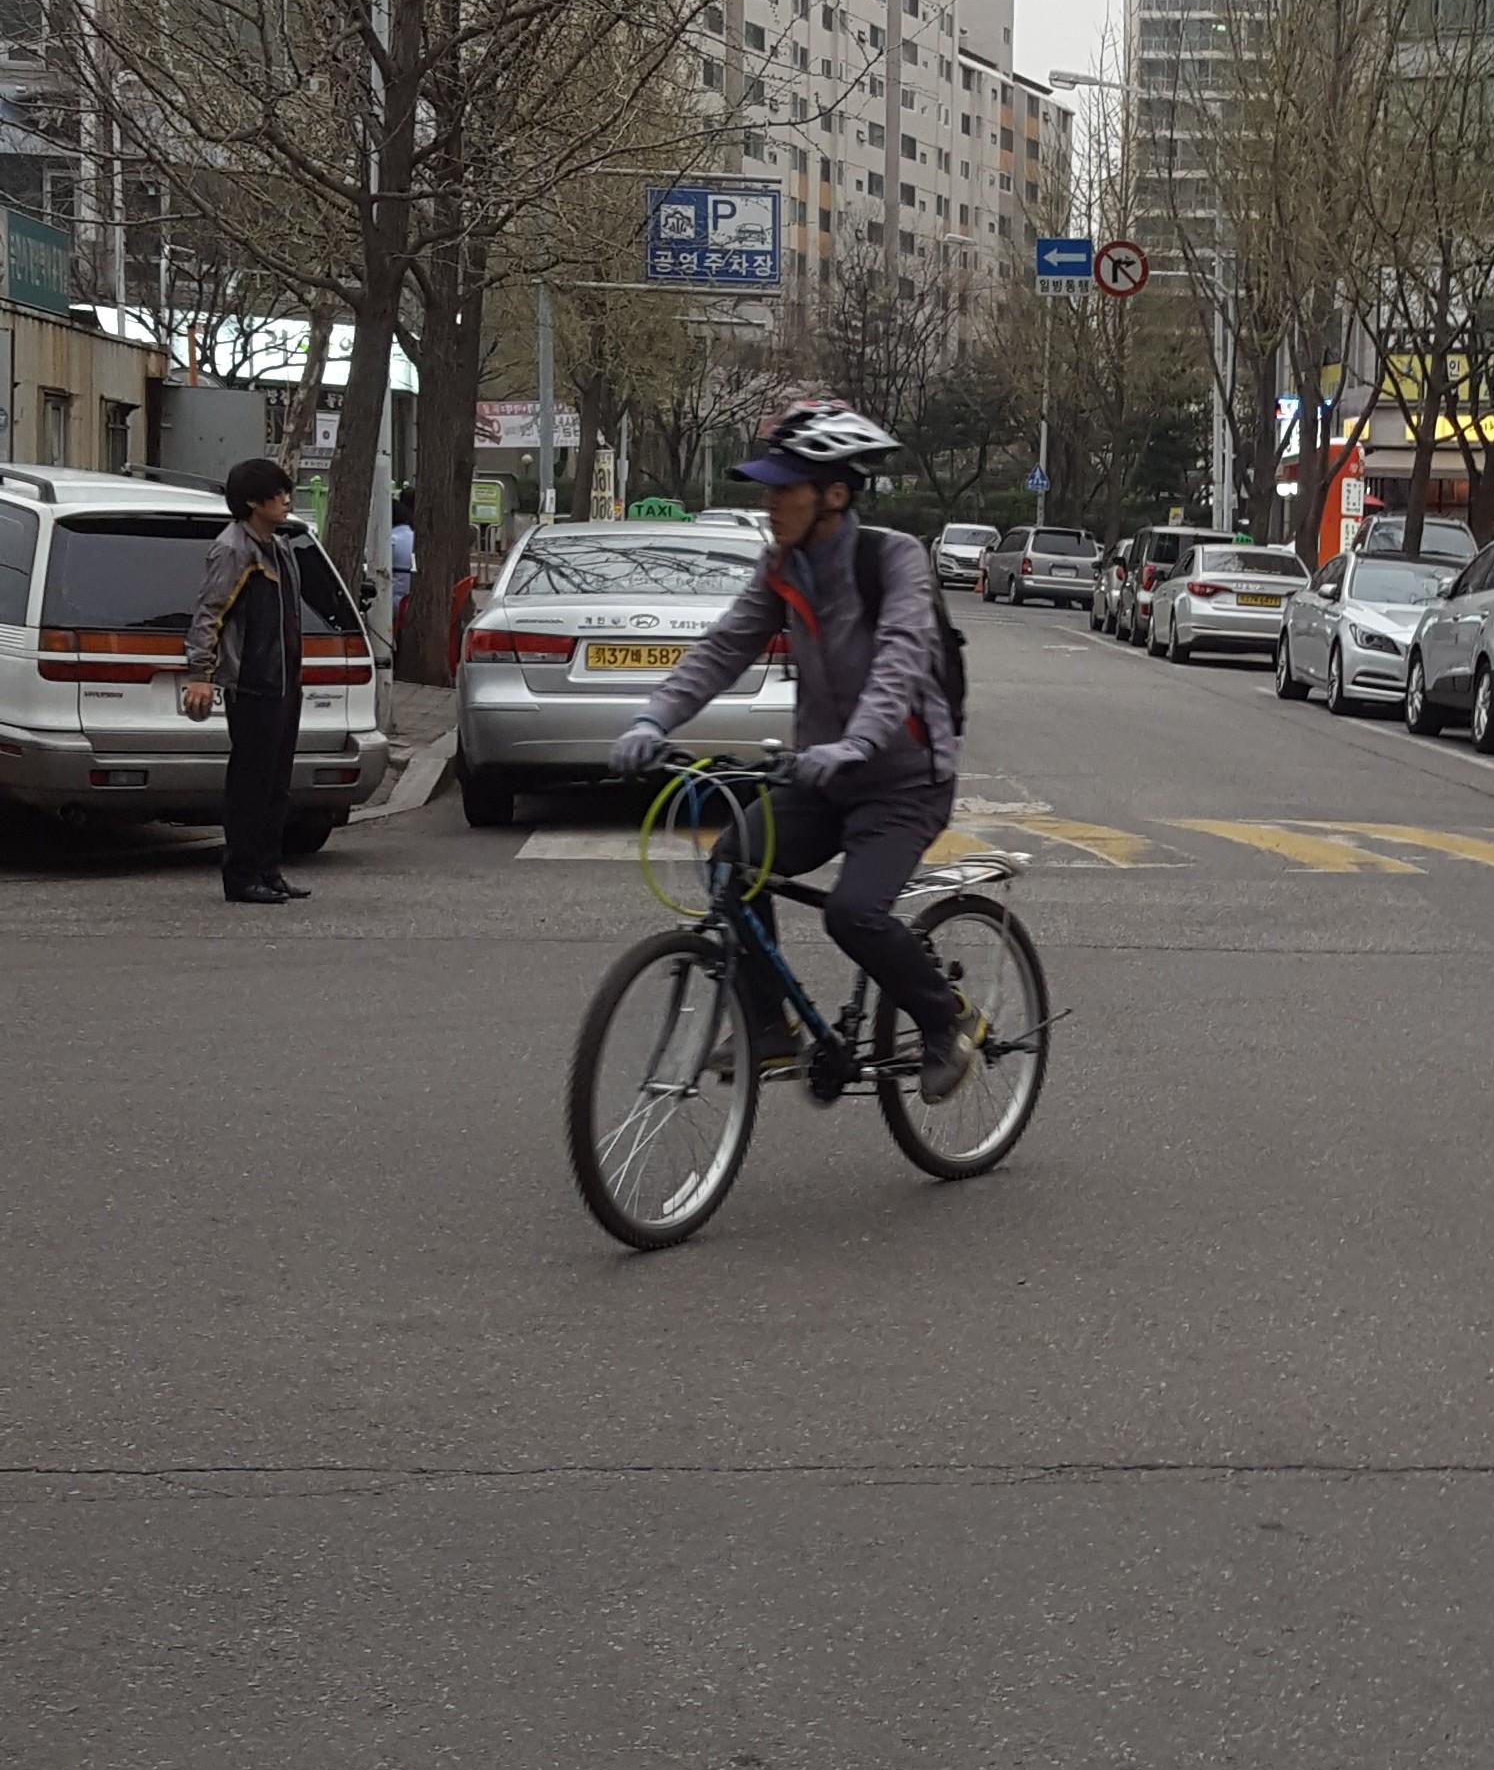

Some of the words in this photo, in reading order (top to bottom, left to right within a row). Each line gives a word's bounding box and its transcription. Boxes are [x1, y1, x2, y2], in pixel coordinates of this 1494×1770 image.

[712, 199, 737, 231] P
[653, 250, 774, 277] 공영주차장
[635, 504, 673, 518] TAXI
[646, 643, 690, 665] 582
